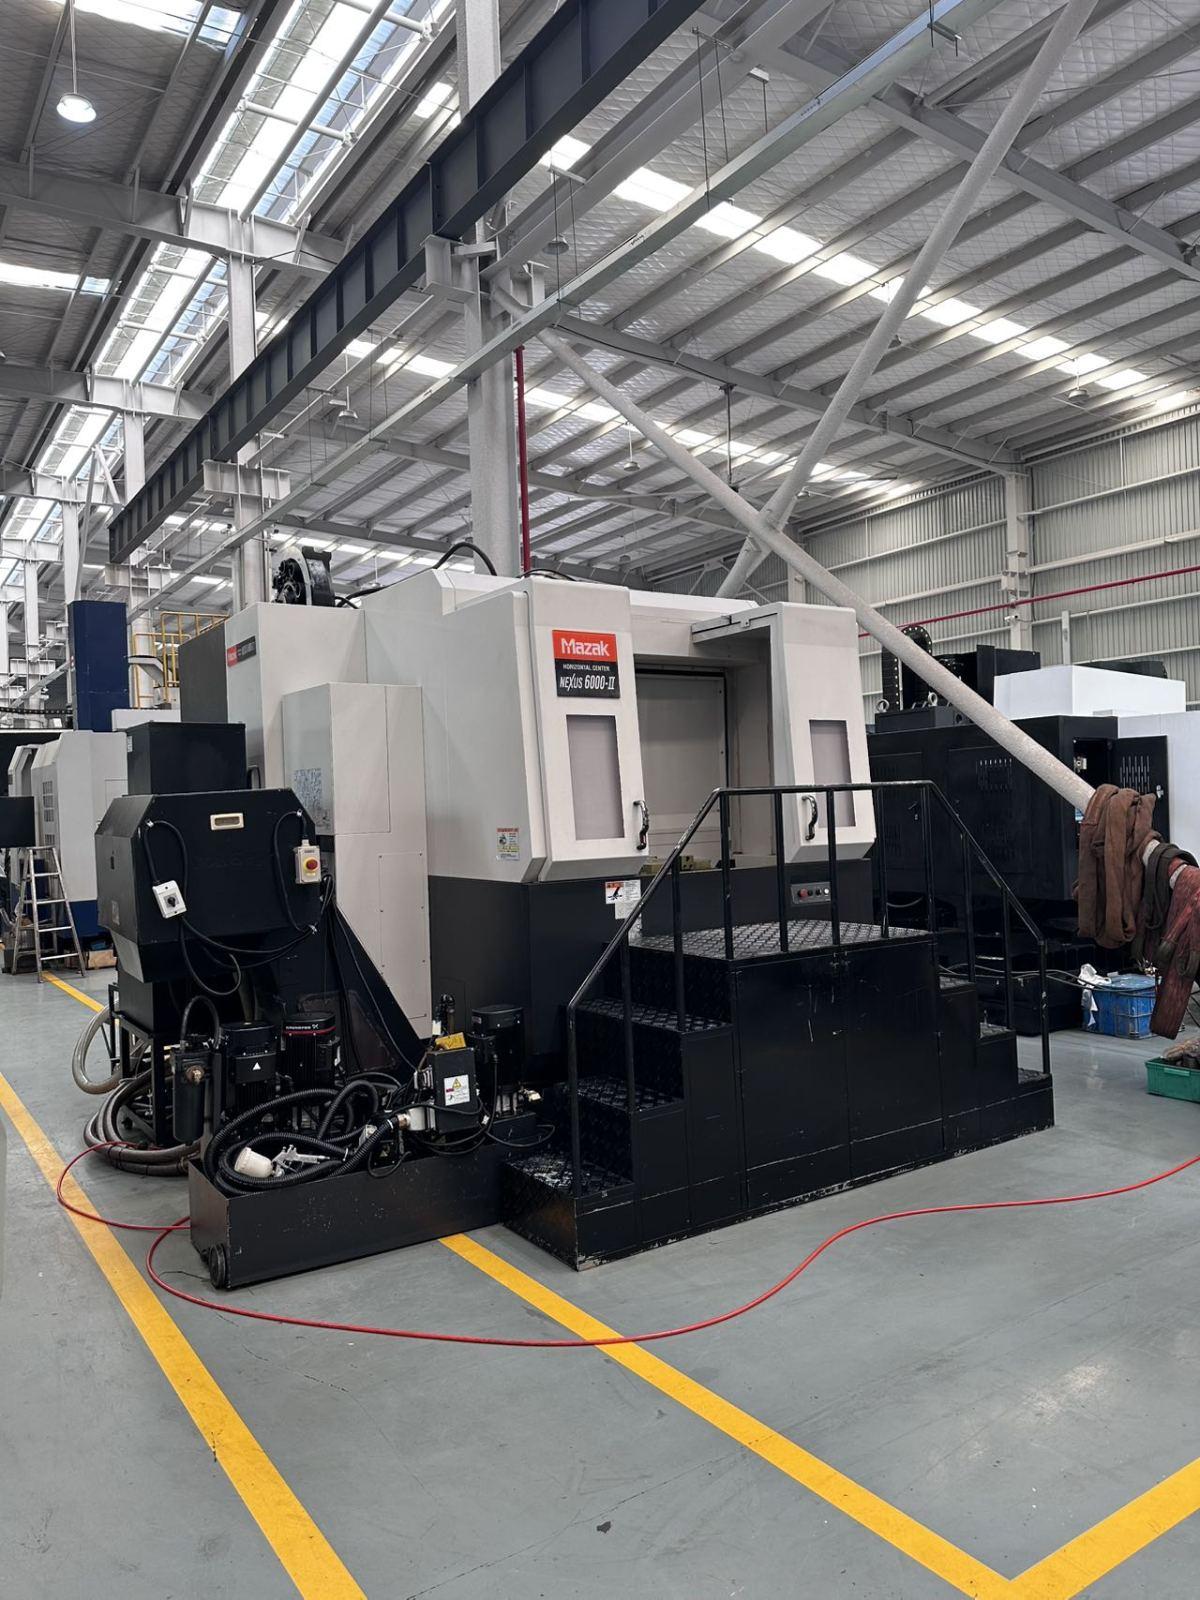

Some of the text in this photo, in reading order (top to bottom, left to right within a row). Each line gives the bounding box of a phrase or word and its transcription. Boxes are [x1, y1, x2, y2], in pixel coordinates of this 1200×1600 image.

[560, 637, 610, 657] Mazak
[562, 663, 610, 672] HORIZONTAL CENTER
[559, 673, 583, 691] NEXUS
